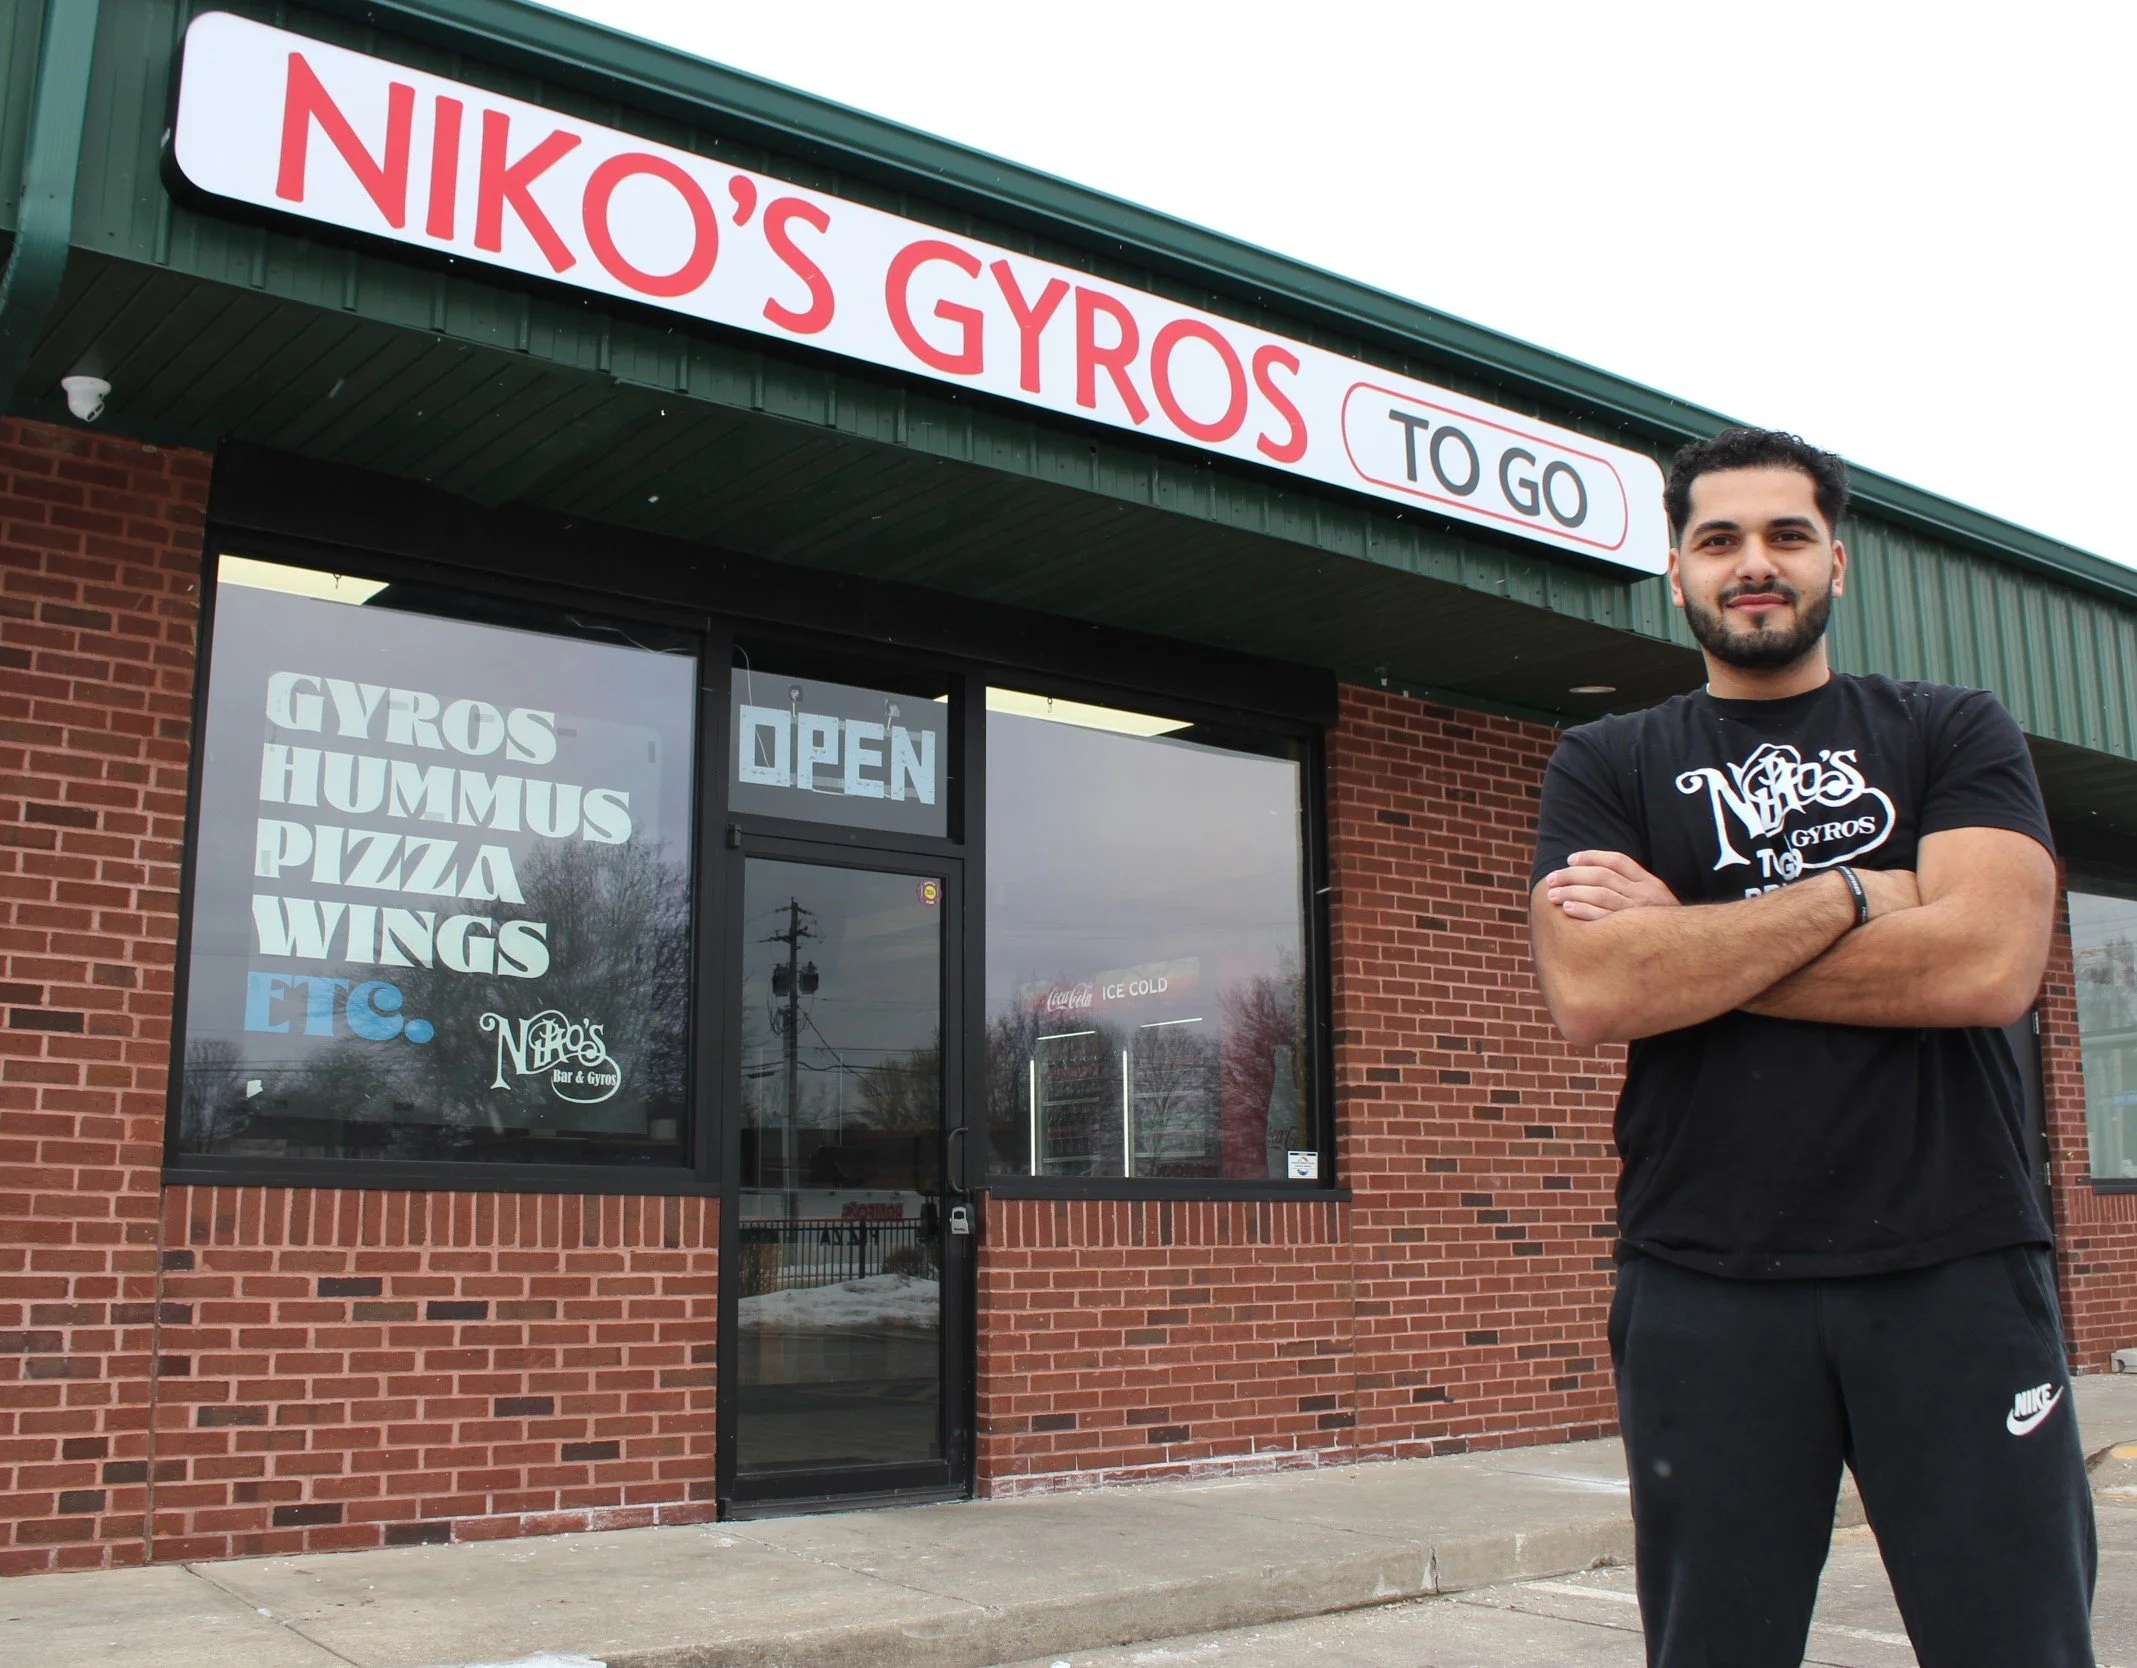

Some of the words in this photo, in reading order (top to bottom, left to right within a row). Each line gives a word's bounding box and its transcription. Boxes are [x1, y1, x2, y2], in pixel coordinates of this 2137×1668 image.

[275, 52, 834, 335] NIKO'S
[885, 239, 1308, 464] GYROS
[1388, 408, 1480, 496] TO
[1498, 446, 1588, 528] GO
[266, 671, 557, 765] GYROS
[739, 704, 936, 805] OPEN
[259, 742, 632, 845] HUMMUS
[1791, 816, 1876, 847] GYROS
[254, 818, 526, 904] PIZZA
[252, 895, 550, 978] WINGS
[244, 972, 435, 1043] ETC.
[1102, 984, 1125, 1000] ICE
[1129, 977, 1168, 996] COLD
[552, 1069, 573, 1084] Bar
[575, 1070, 585, 1084] &
[587, 1071, 617, 1087] Gyros
[2013, 1383, 2052, 1417] NIKE
